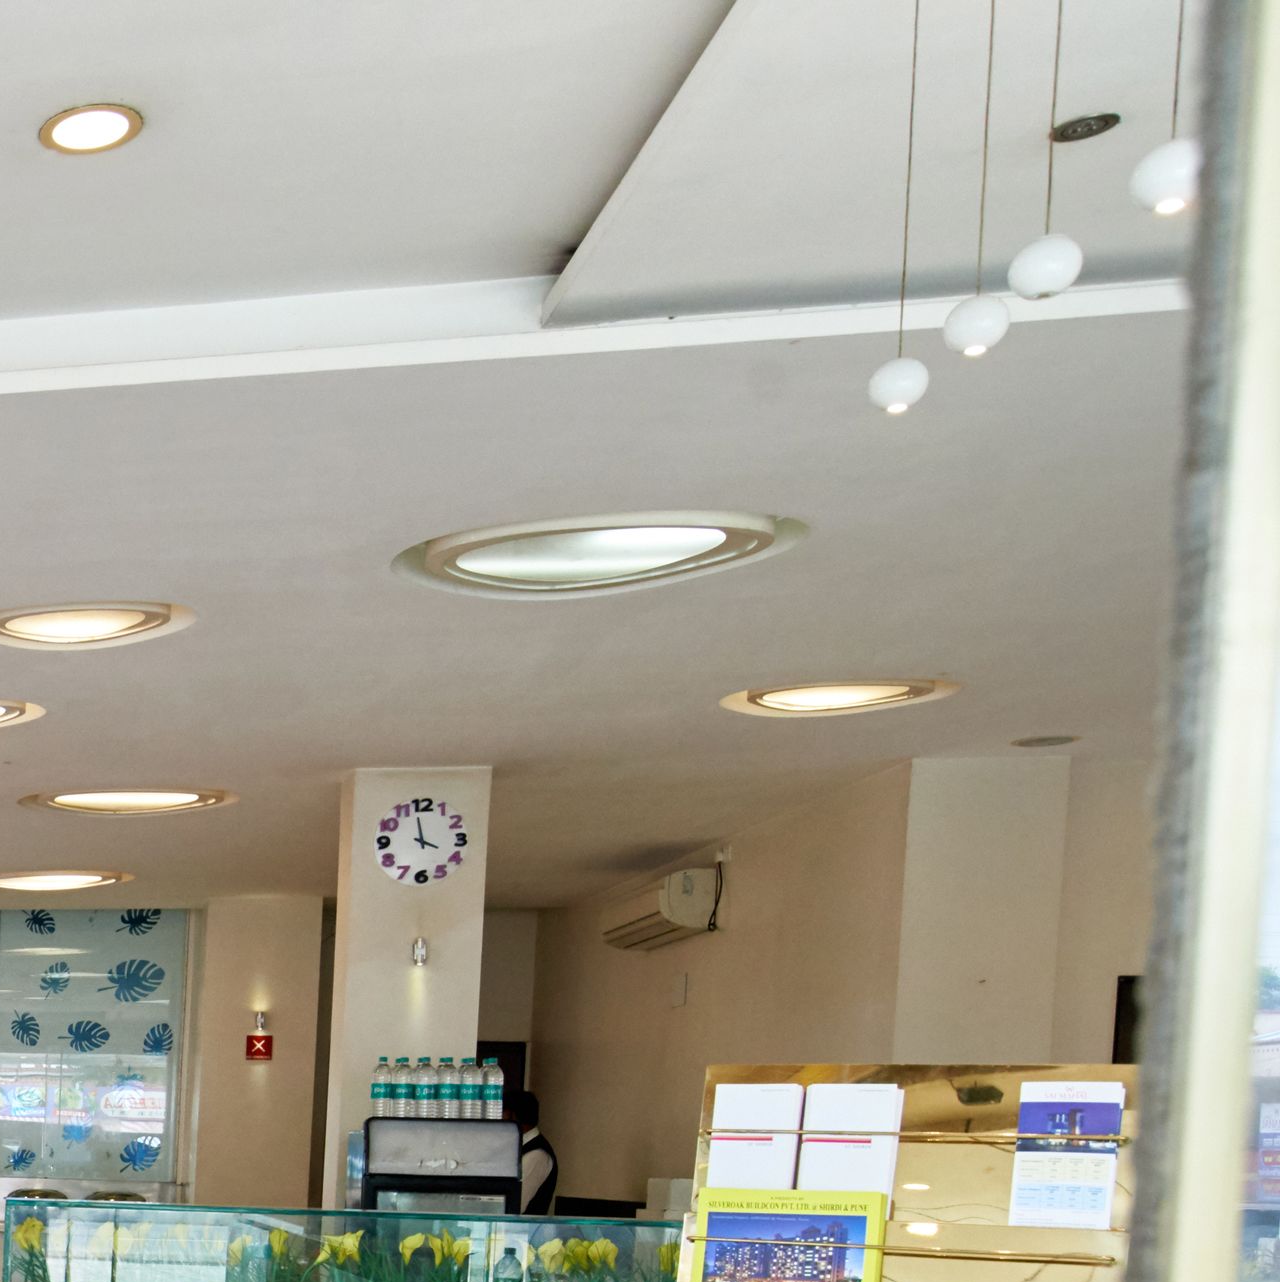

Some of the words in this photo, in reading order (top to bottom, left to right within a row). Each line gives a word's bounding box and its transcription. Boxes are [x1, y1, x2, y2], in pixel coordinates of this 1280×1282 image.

[393, 803, 410, 818] 11
[411, 798, 433, 813] 12
[437, 802, 446, 816] 1
[380, 817, 399, 832] 10
[449, 814, 463, 829] 2
[376, 835, 391, 850] 9
[454, 833, 467, 847] 3
[381, 853, 395, 867] 8
[448, 850, 463, 865] 4
[397, 865, 411, 880] 7
[414, 869, 429, 884] 6
[433, 864, 447, 879] 5
[708, 1201, 744, 1209] SILVEROAK
